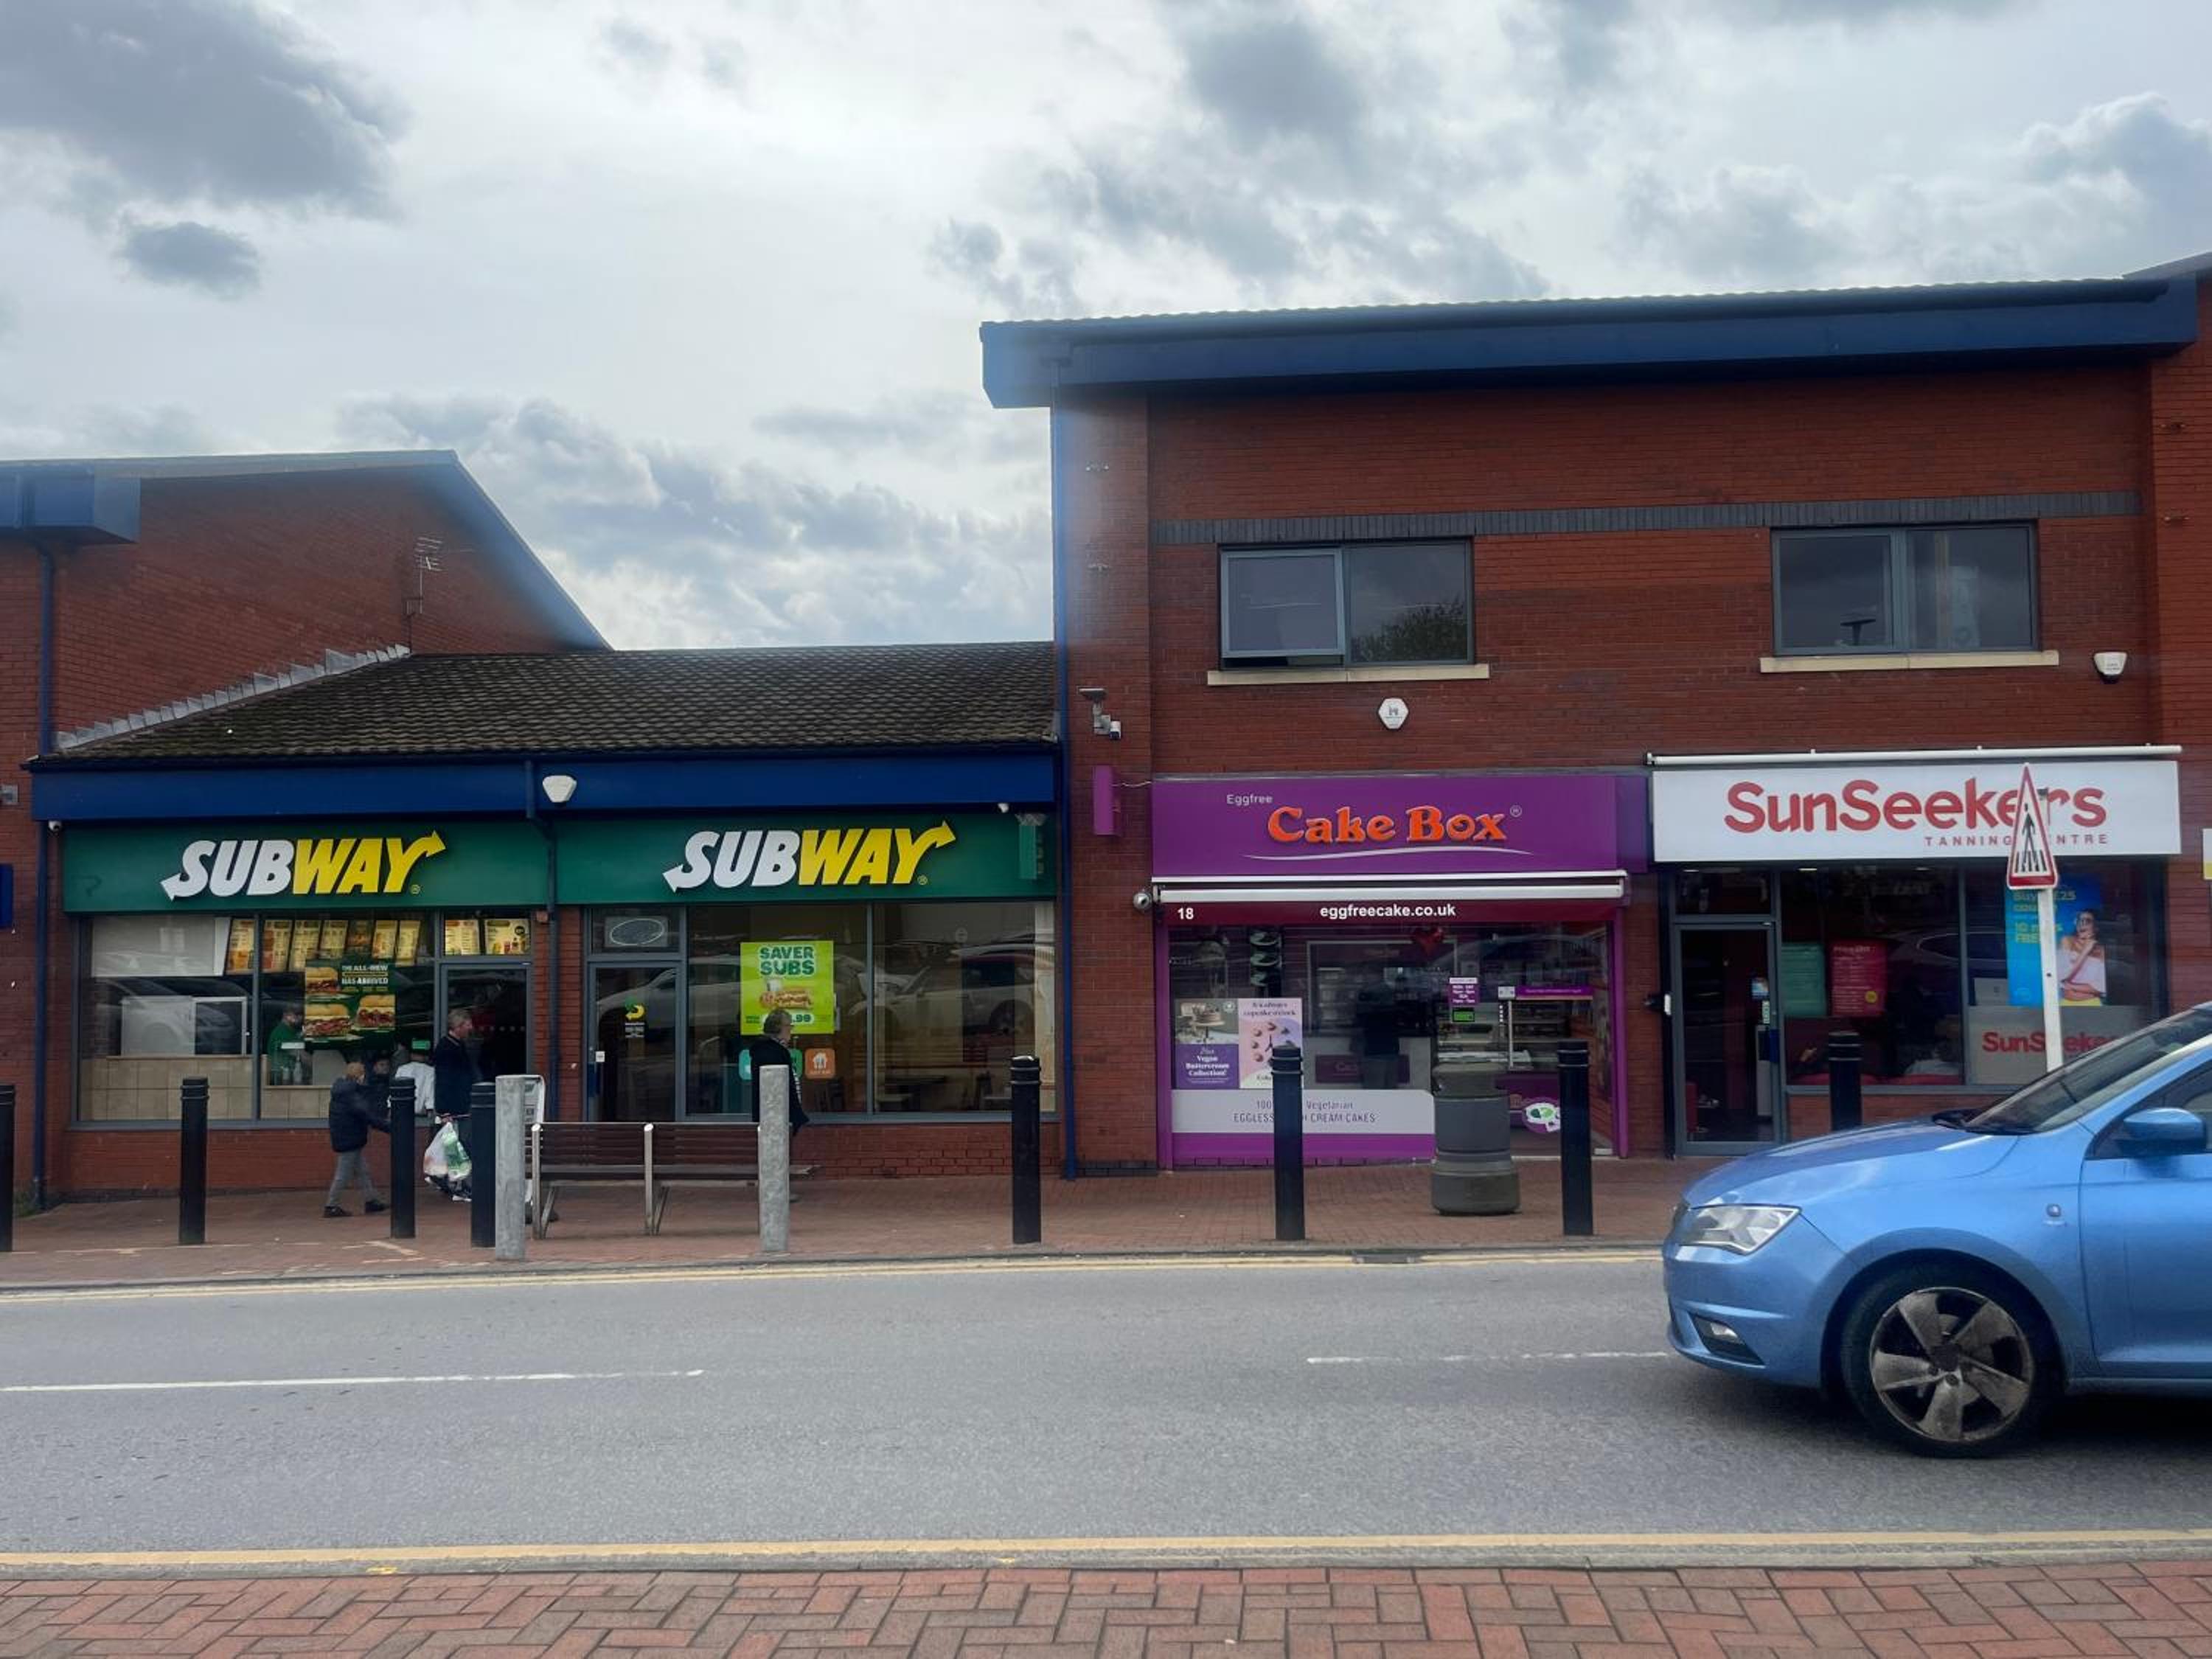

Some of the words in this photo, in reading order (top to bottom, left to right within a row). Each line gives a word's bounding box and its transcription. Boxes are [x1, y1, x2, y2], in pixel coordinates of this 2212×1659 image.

[1226, 794, 1273, 806] Eggfree
[1267, 806, 1396, 843] Cake
[1406, 805, 1507, 841] Box
[1925, 835, 2012, 846] TANNING
[2049, 834, 2107, 844] NTRE
[663, 820, 956, 893] SUBWAY
[161, 830, 446, 901] SUBWAY
[1177, 908, 1194, 920] 18
[1320, 904, 1456, 921] eggfreecake.co.uk
[759, 946, 815, 959] SAVER
[759, 959, 815, 975] SUBS
[1306, 1100, 1354, 1111] Vegetarian
[1310, 1113, 1343, 1123] CREAM
[1346, 1113, 1376, 1123] CAKES
